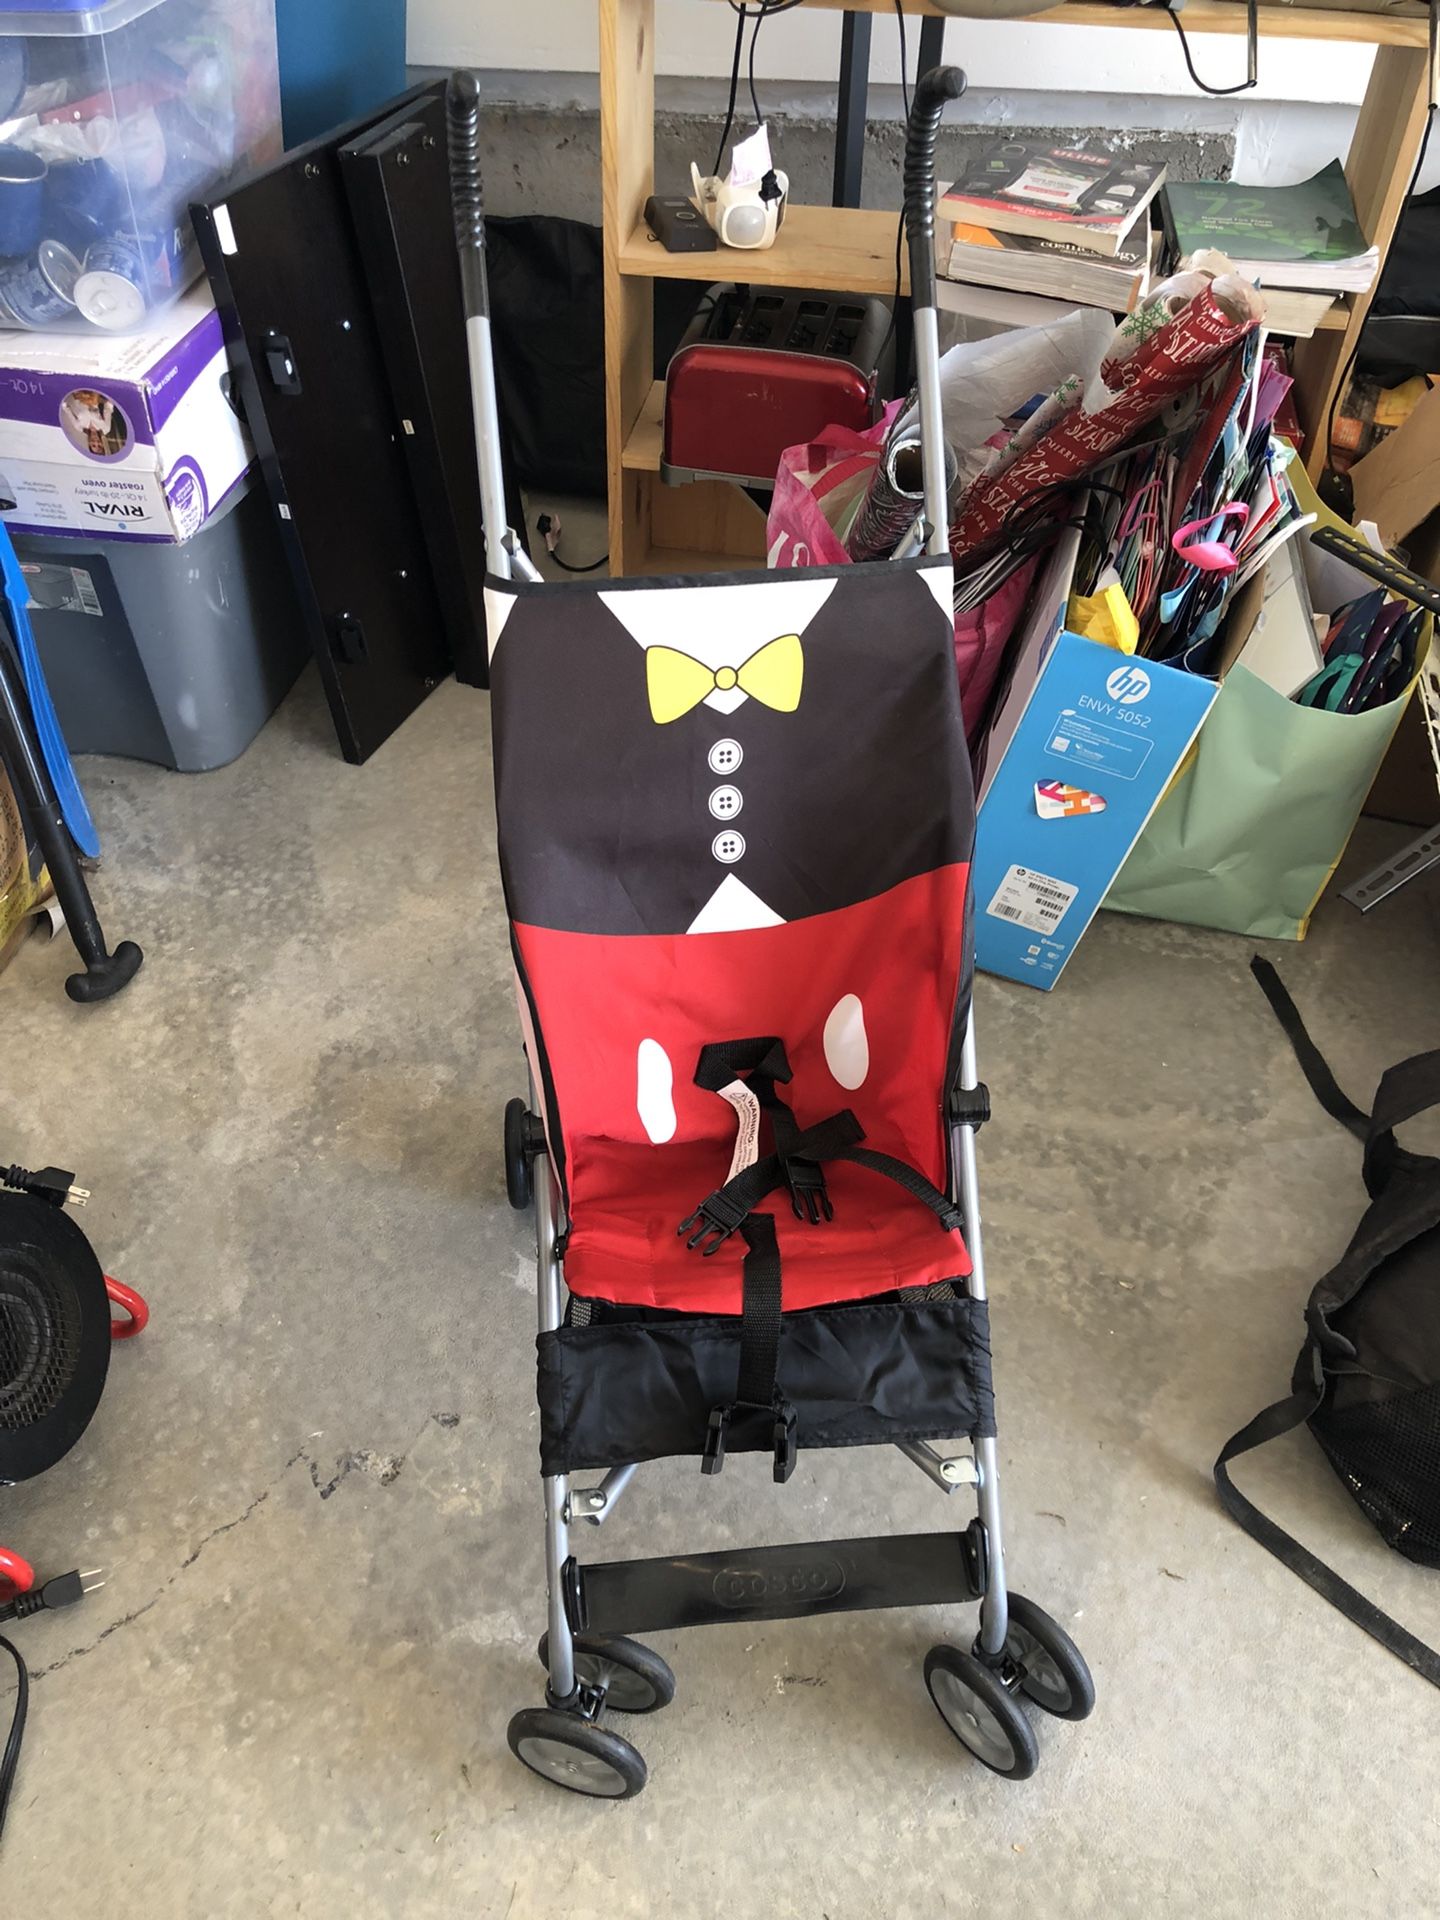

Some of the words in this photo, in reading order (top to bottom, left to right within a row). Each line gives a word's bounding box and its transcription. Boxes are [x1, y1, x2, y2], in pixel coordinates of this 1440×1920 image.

[1053, 149, 1109, 166] ULINE
[1196, 196, 1268, 217] 72
[81, 479, 106, 489] oven
[109, 482, 145, 491] roaster
[84, 501, 145, 517] RIVAL
[1107, 665, 1150, 705] hp
[1078, 694, 1115, 716] ENVY
[1115, 708, 1152, 729] 5052
